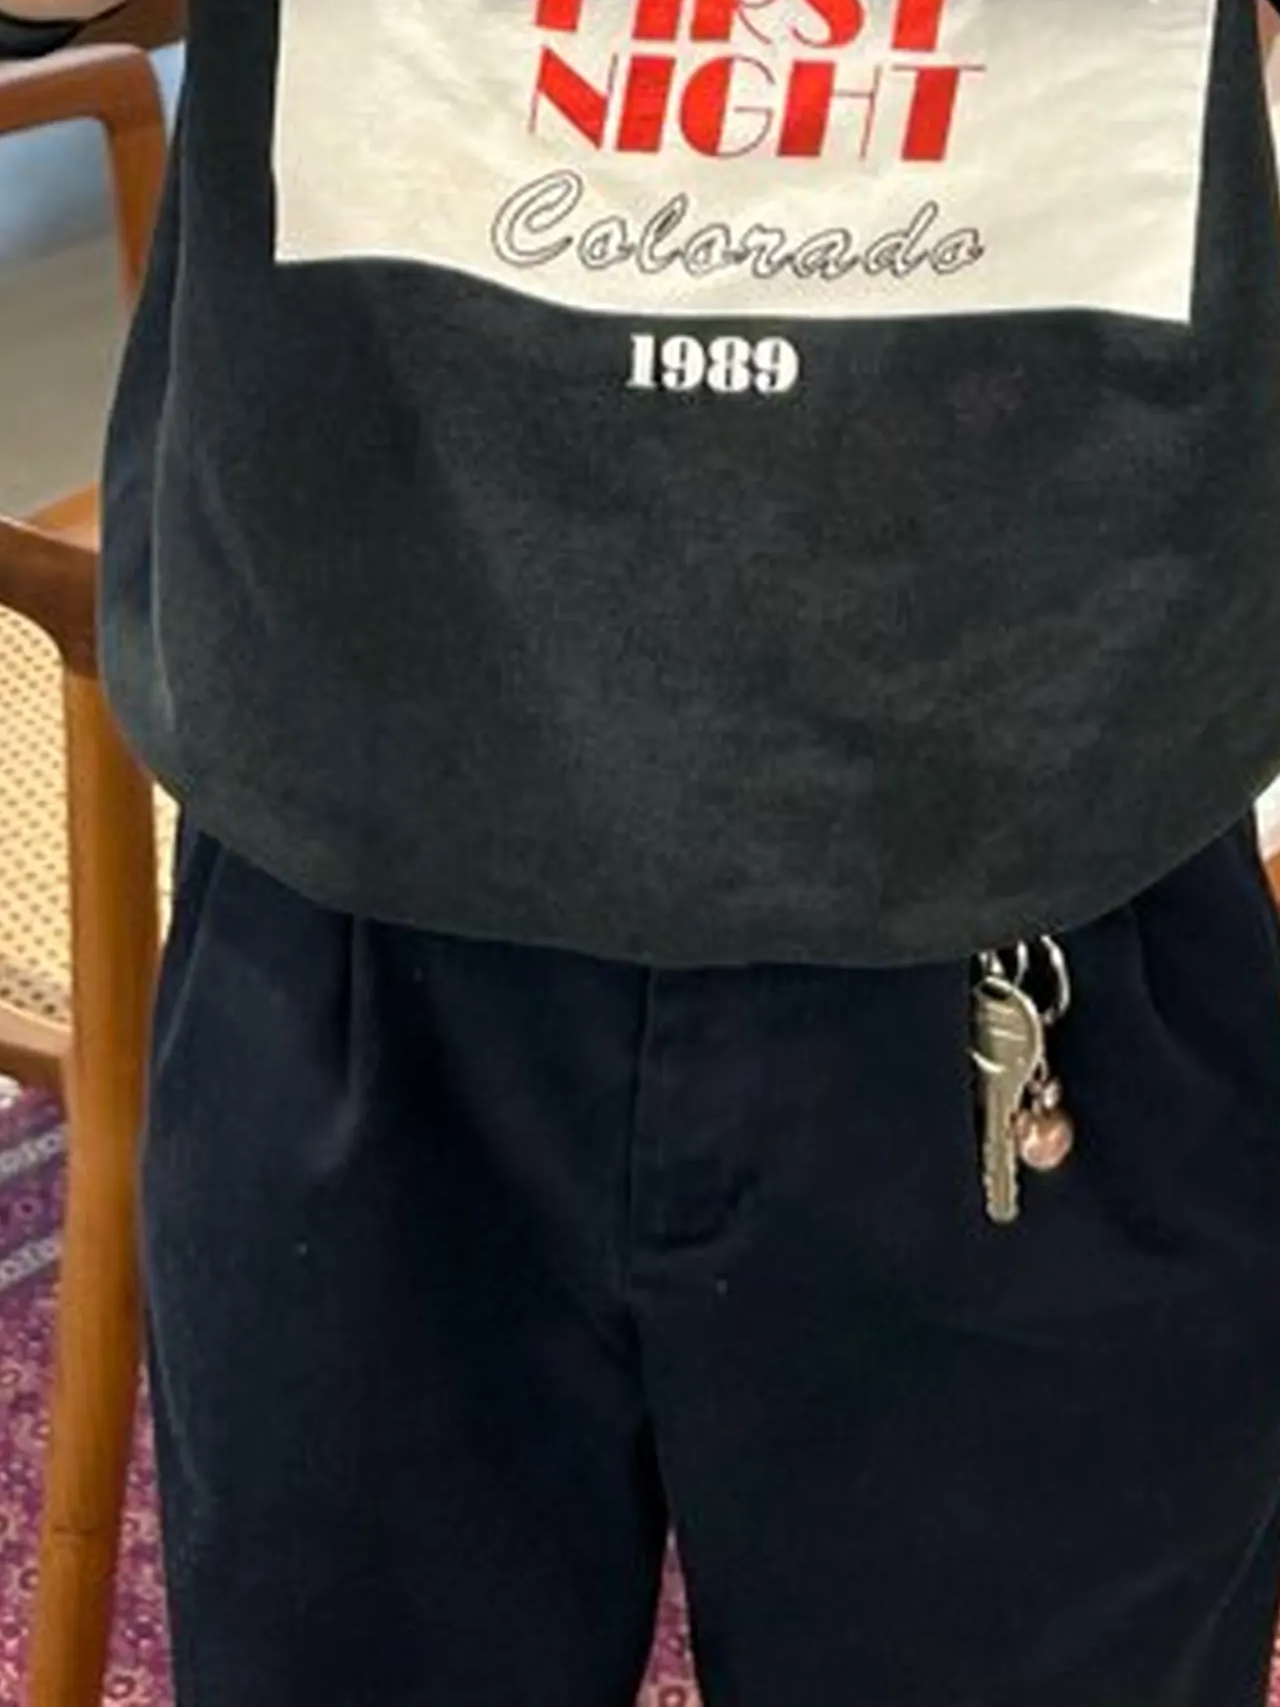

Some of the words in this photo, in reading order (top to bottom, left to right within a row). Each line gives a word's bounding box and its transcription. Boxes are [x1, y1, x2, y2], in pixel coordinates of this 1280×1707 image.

[527, 45, 987, 163] NIGHT
[490, 168, 986, 281] Colorado
[625, 332, 800, 394] 1989
